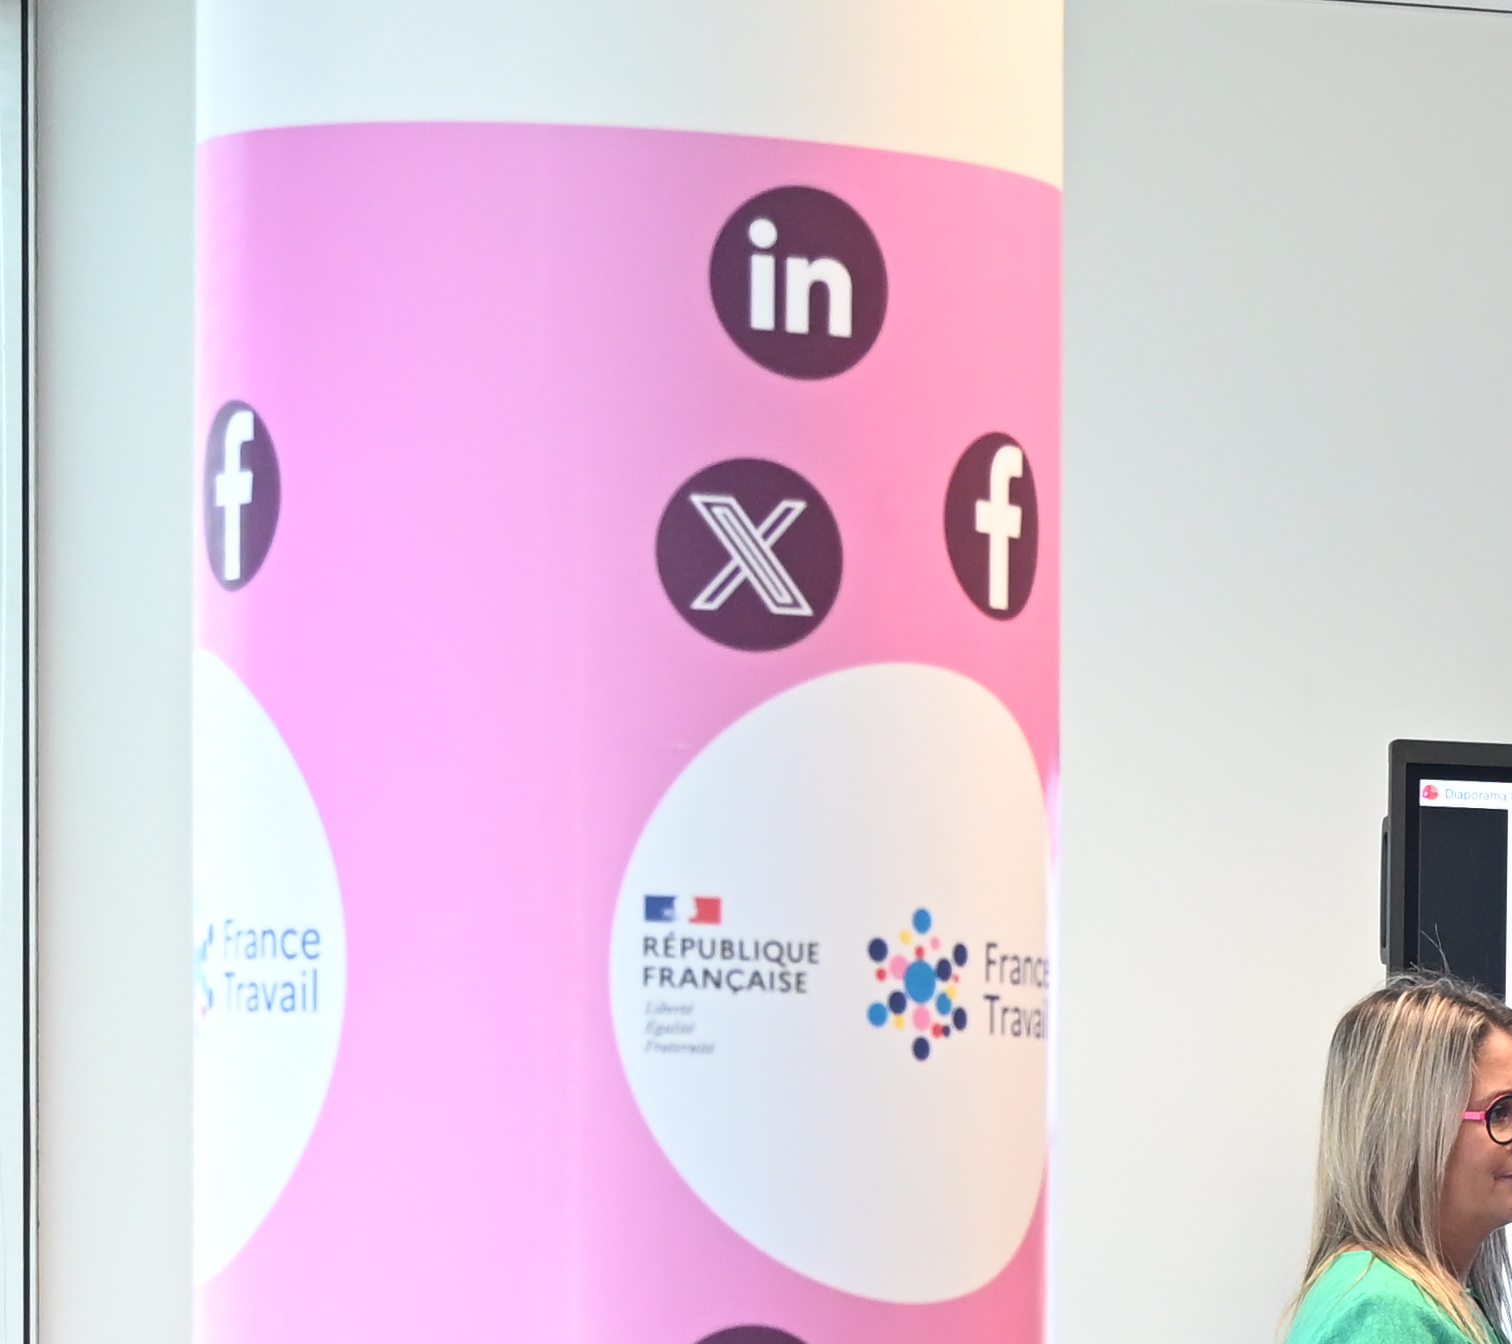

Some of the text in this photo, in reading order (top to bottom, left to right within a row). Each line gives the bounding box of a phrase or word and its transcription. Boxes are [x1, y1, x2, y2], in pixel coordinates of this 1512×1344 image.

[748, 217, 853, 340] in
[1444, 788, 1508, 803] Diaporama
[224, 919, 320, 960] France
[643, 931, 820, 967] RÉPUBLIQUE
[224, 968, 318, 1012] Travail
[643, 965, 808, 995] FRANÇAISE
